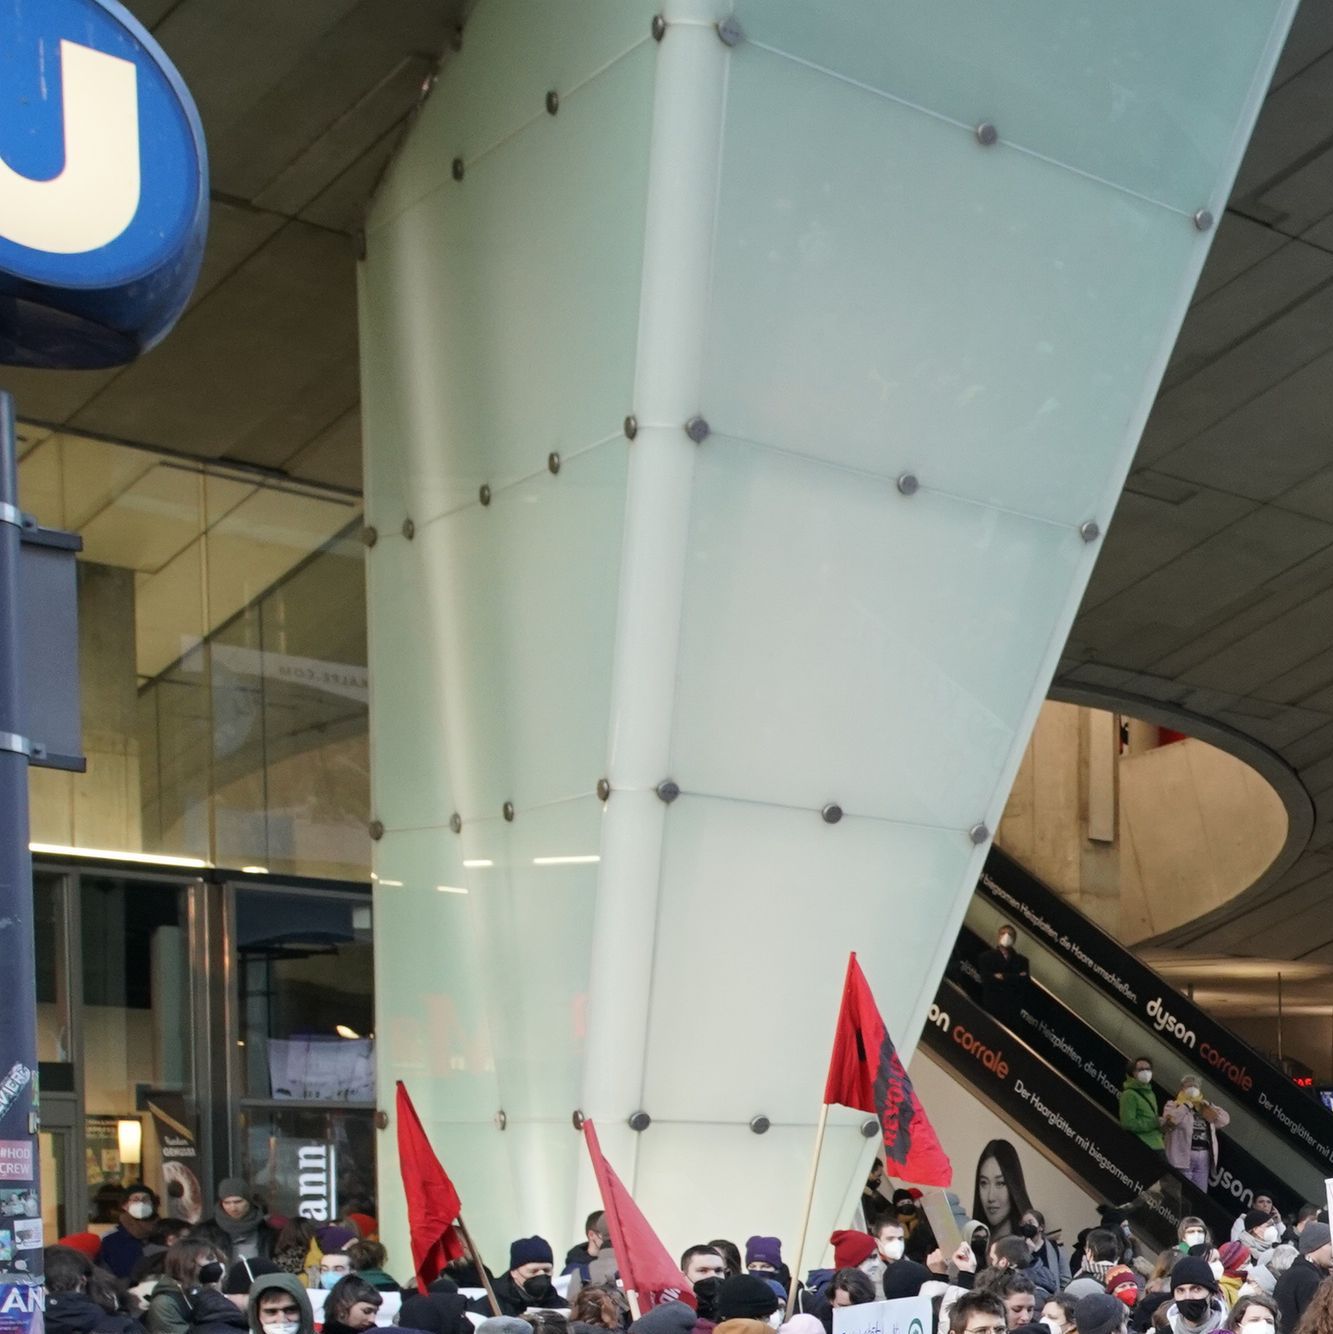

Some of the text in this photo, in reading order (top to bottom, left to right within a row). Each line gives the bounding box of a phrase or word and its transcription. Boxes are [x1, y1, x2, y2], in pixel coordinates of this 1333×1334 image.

[953, 1025, 1009, 1079] corrale
[1014, 1079, 1031, 1099] Der
[1031, 1095, 1077, 1138] Haarglätter
[1076, 1134, 1090, 1151] mit
[1089, 1142, 1134, 1188] biegsamen
[1083, 1061, 1097, 1078] die
[1146, 997, 1197, 1048] dyson
[1200, 1043, 1254, 1092] corrale
[1258, 1092, 1273, 1115] Der
[1273, 1106, 1317, 1148] Haarglätter
[1316, 1142, 1331, 1159] mit
[1208, 1166, 1256, 1209] yson
